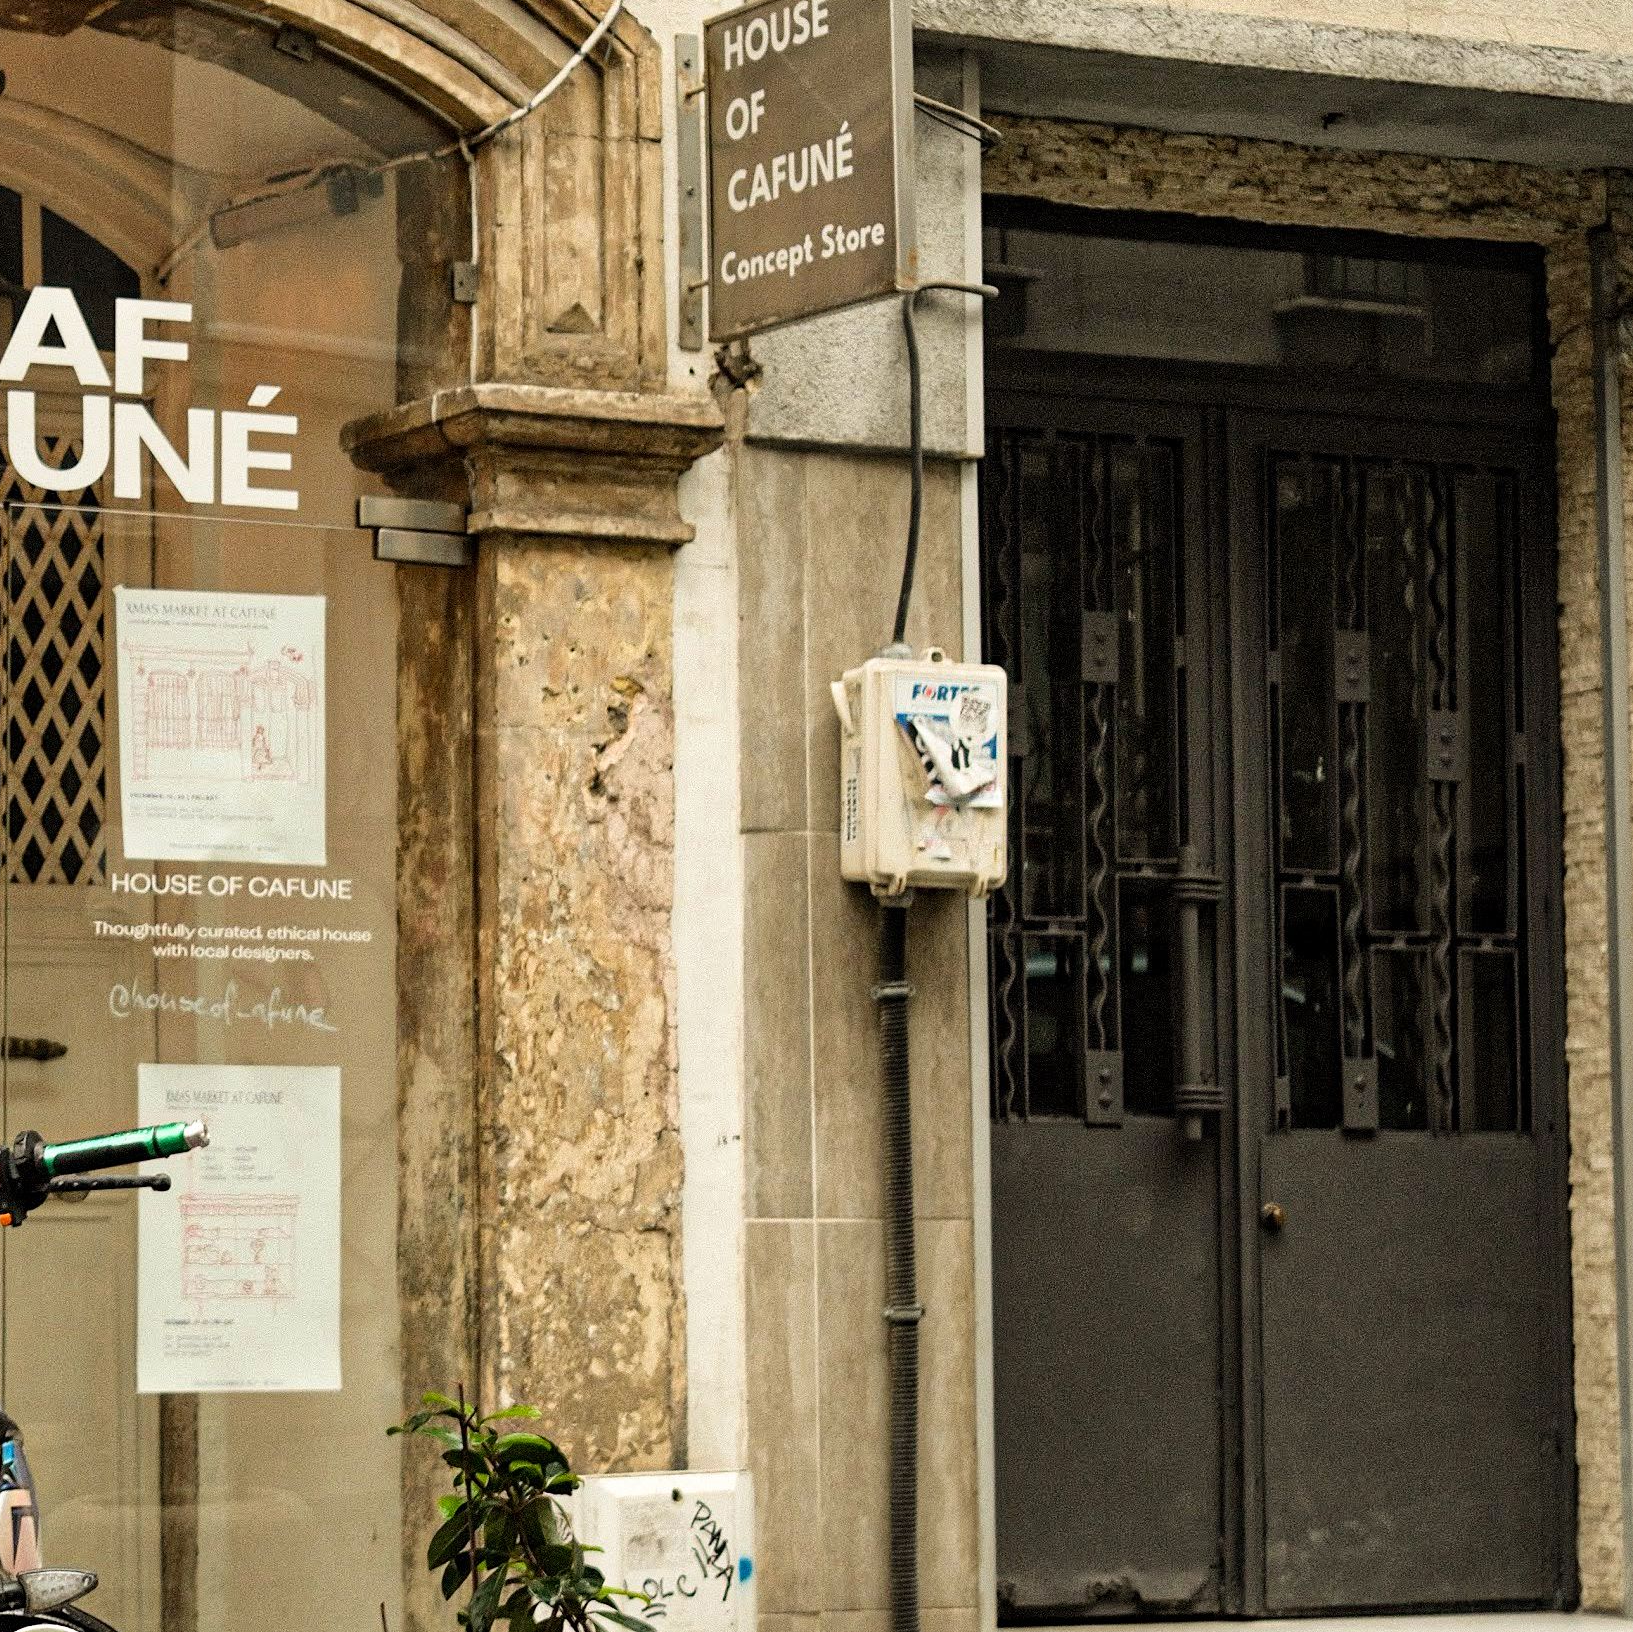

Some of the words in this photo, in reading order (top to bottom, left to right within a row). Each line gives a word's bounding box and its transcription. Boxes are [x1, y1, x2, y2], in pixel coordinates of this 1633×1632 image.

[725, 88, 766, 141] OF
[726, 121, 854, 214] CAFUNÉ
[720, 233, 813, 285] Concept
[820, 220, 886, 261] Store
[6, 384, 300, 511] UNÉ
[111, 872, 203, 896] HOUSE
[207, 875, 243, 897] OF
[248, 876, 353, 899] CAFUNE
[93, 920, 196, 940] Thoughtfully
[267, 925, 321, 942] ethical
[322, 926, 372, 943] house
[153, 943, 189, 959] with
[190, 943, 230, 959] local
[231, 944, 315, 962] designers.
